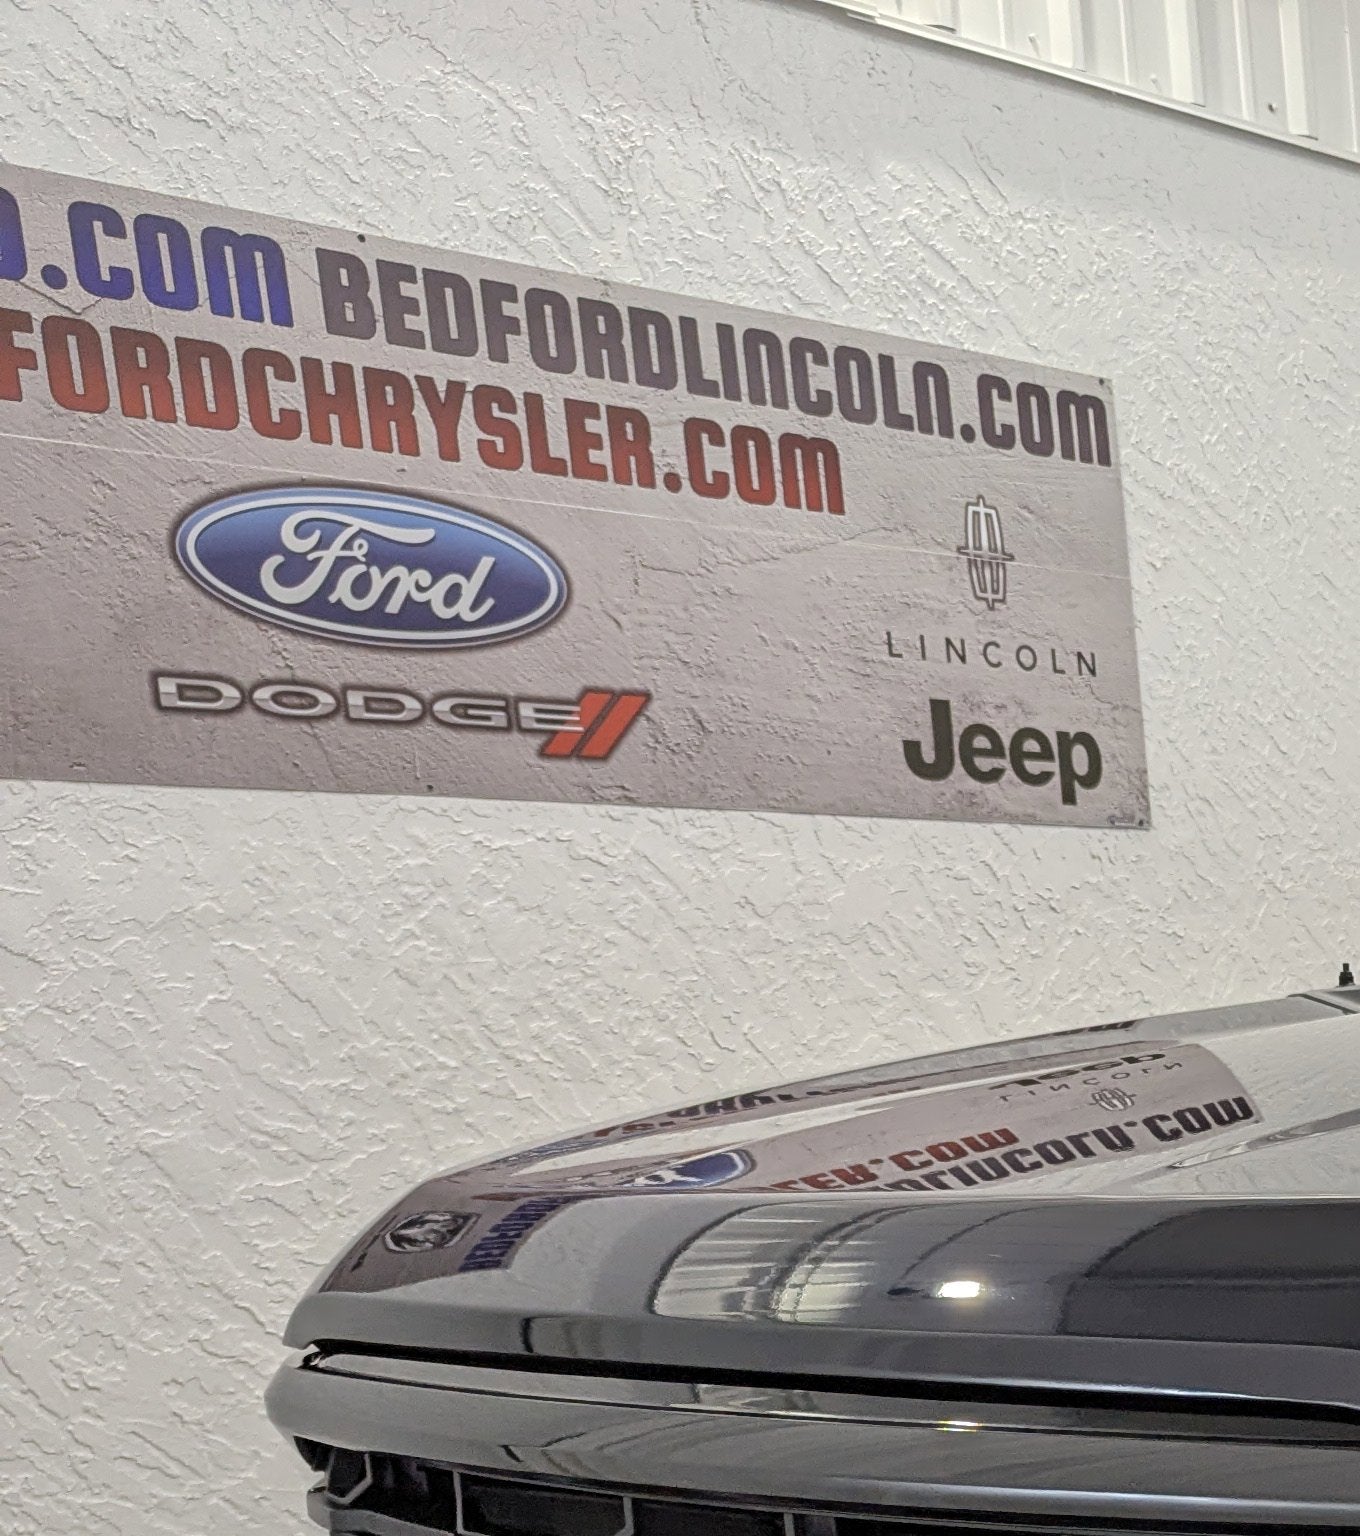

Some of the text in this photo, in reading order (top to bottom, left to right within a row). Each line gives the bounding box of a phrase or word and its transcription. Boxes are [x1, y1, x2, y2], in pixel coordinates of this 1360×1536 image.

[315, 247, 1112, 467] BEDFORDLINCOLN.COM
[260, 509, 496, 623] Ford
[157, 676, 585, 735] DODGE
[885, 630, 1098, 678] LINCOLN
[903, 698, 1103, 806] Jeep
